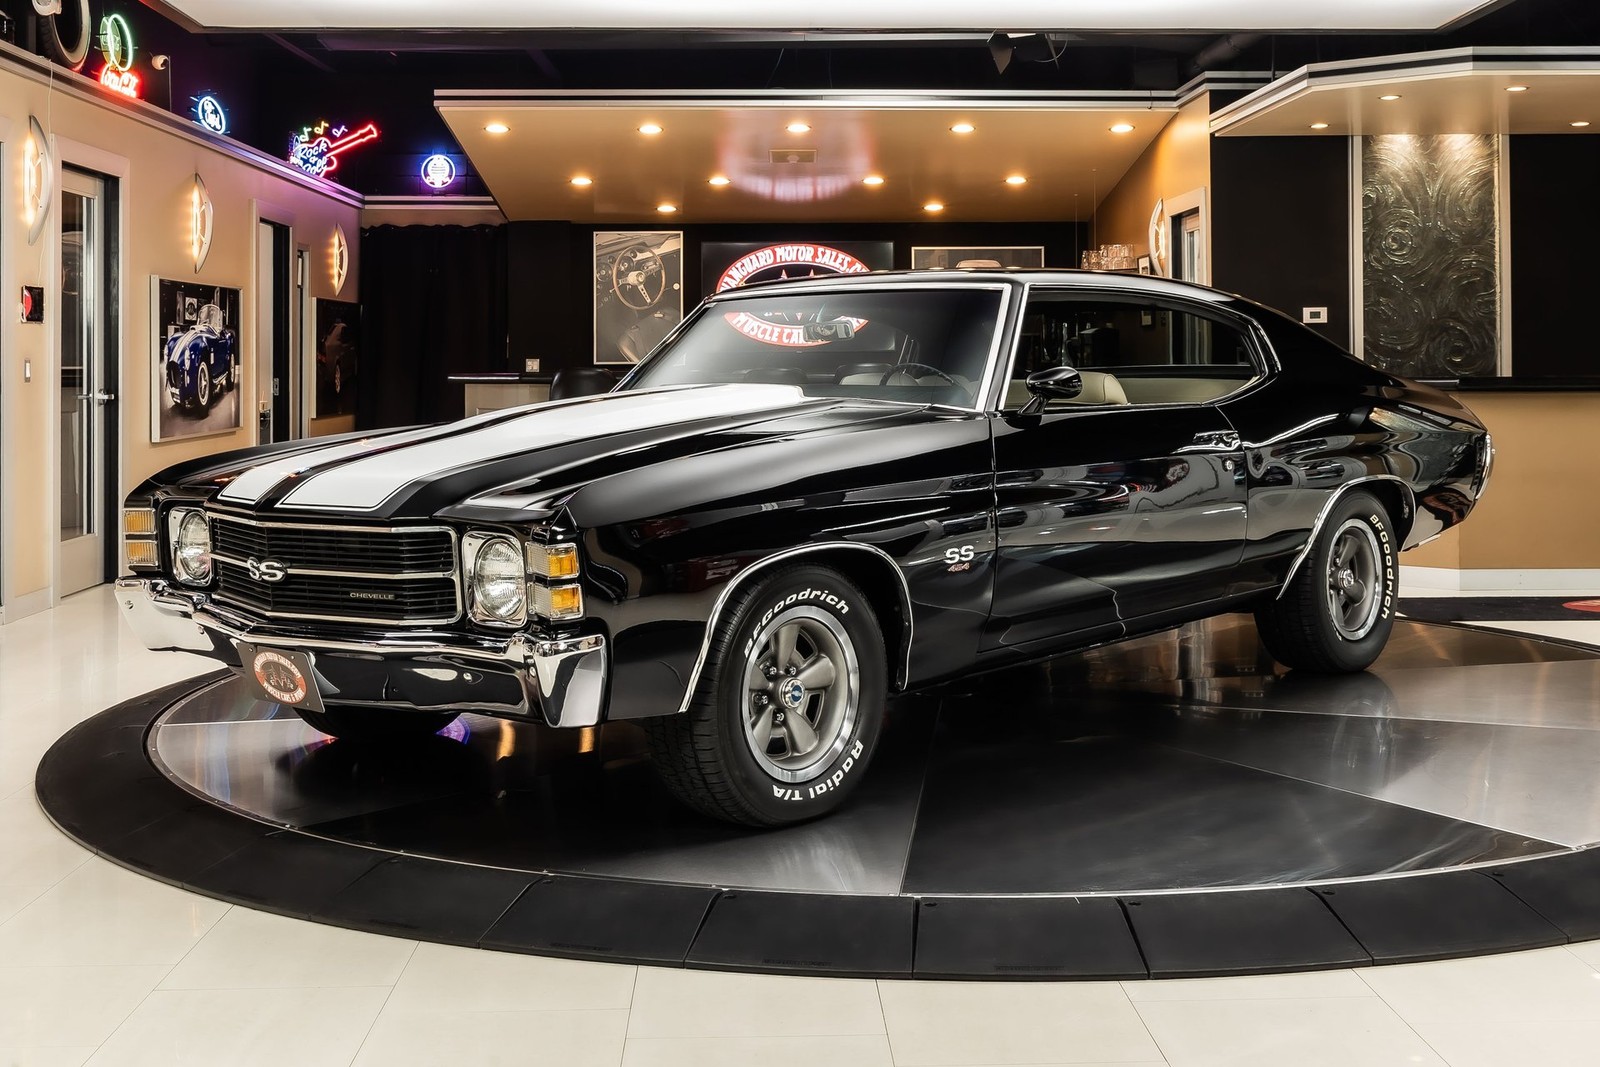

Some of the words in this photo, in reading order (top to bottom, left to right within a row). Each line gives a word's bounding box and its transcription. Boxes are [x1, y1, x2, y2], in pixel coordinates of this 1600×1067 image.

[300, 139, 328, 159] Rock
[774, 246, 814, 261] MOTOR
[733, 313, 780, 343] MUSCLE
[944, 545, 974, 564] SS
[246, 557, 287, 582] SS
[1370, 514, 1395, 619] BFGoodrich
[350, 592, 394, 600] CHEVELLE
[744, 588, 849, 658] BFGoodrich
[809, 740, 863, 798] Radial
[773, 785, 803, 800] T/A
